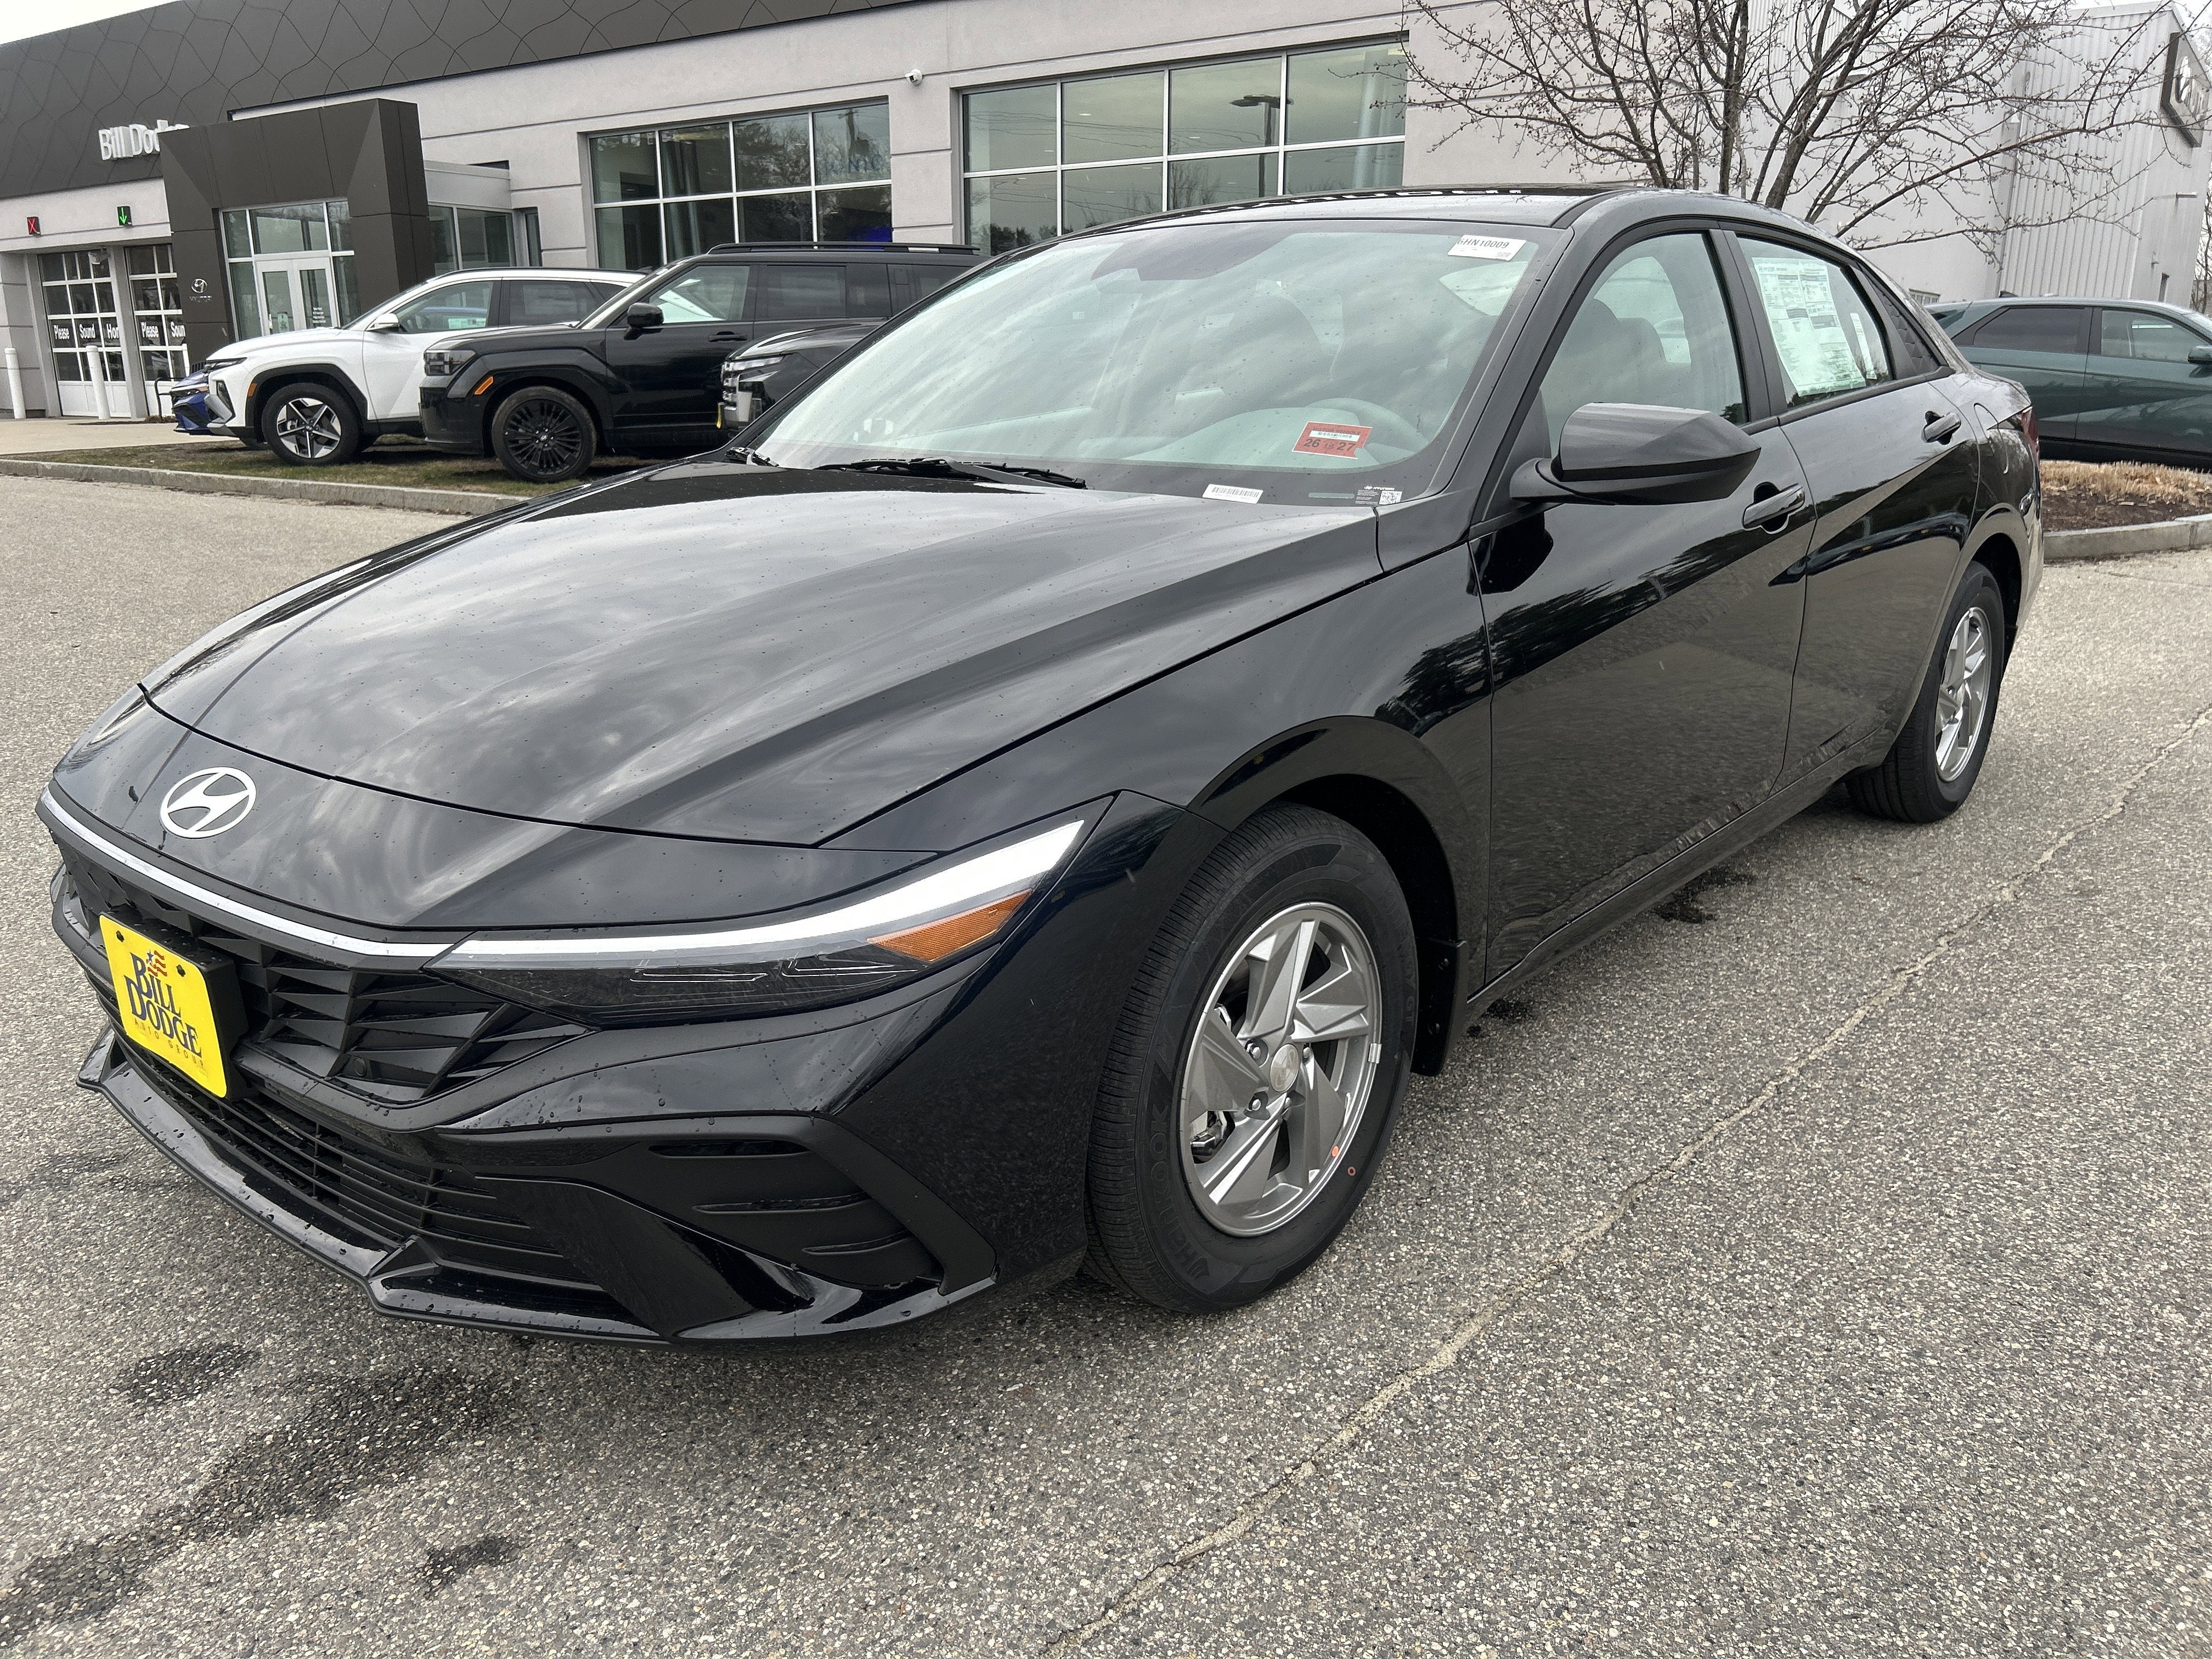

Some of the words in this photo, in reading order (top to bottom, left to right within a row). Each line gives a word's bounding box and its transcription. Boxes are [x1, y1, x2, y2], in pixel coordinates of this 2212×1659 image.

[99, 126, 132, 161] Bill
[54, 325, 70, 340] Please
[80, 324, 95, 339] Sound
[106, 323, 119, 339] Hor
[140, 322, 159, 338] Please
[171, 321, 186, 337] Soun
[1303, 438, 1321, 448] 26
[1336, 442, 1357, 452] 27
[129, 952, 181, 1018] BILL
[123, 974, 202, 1058] DODGE
